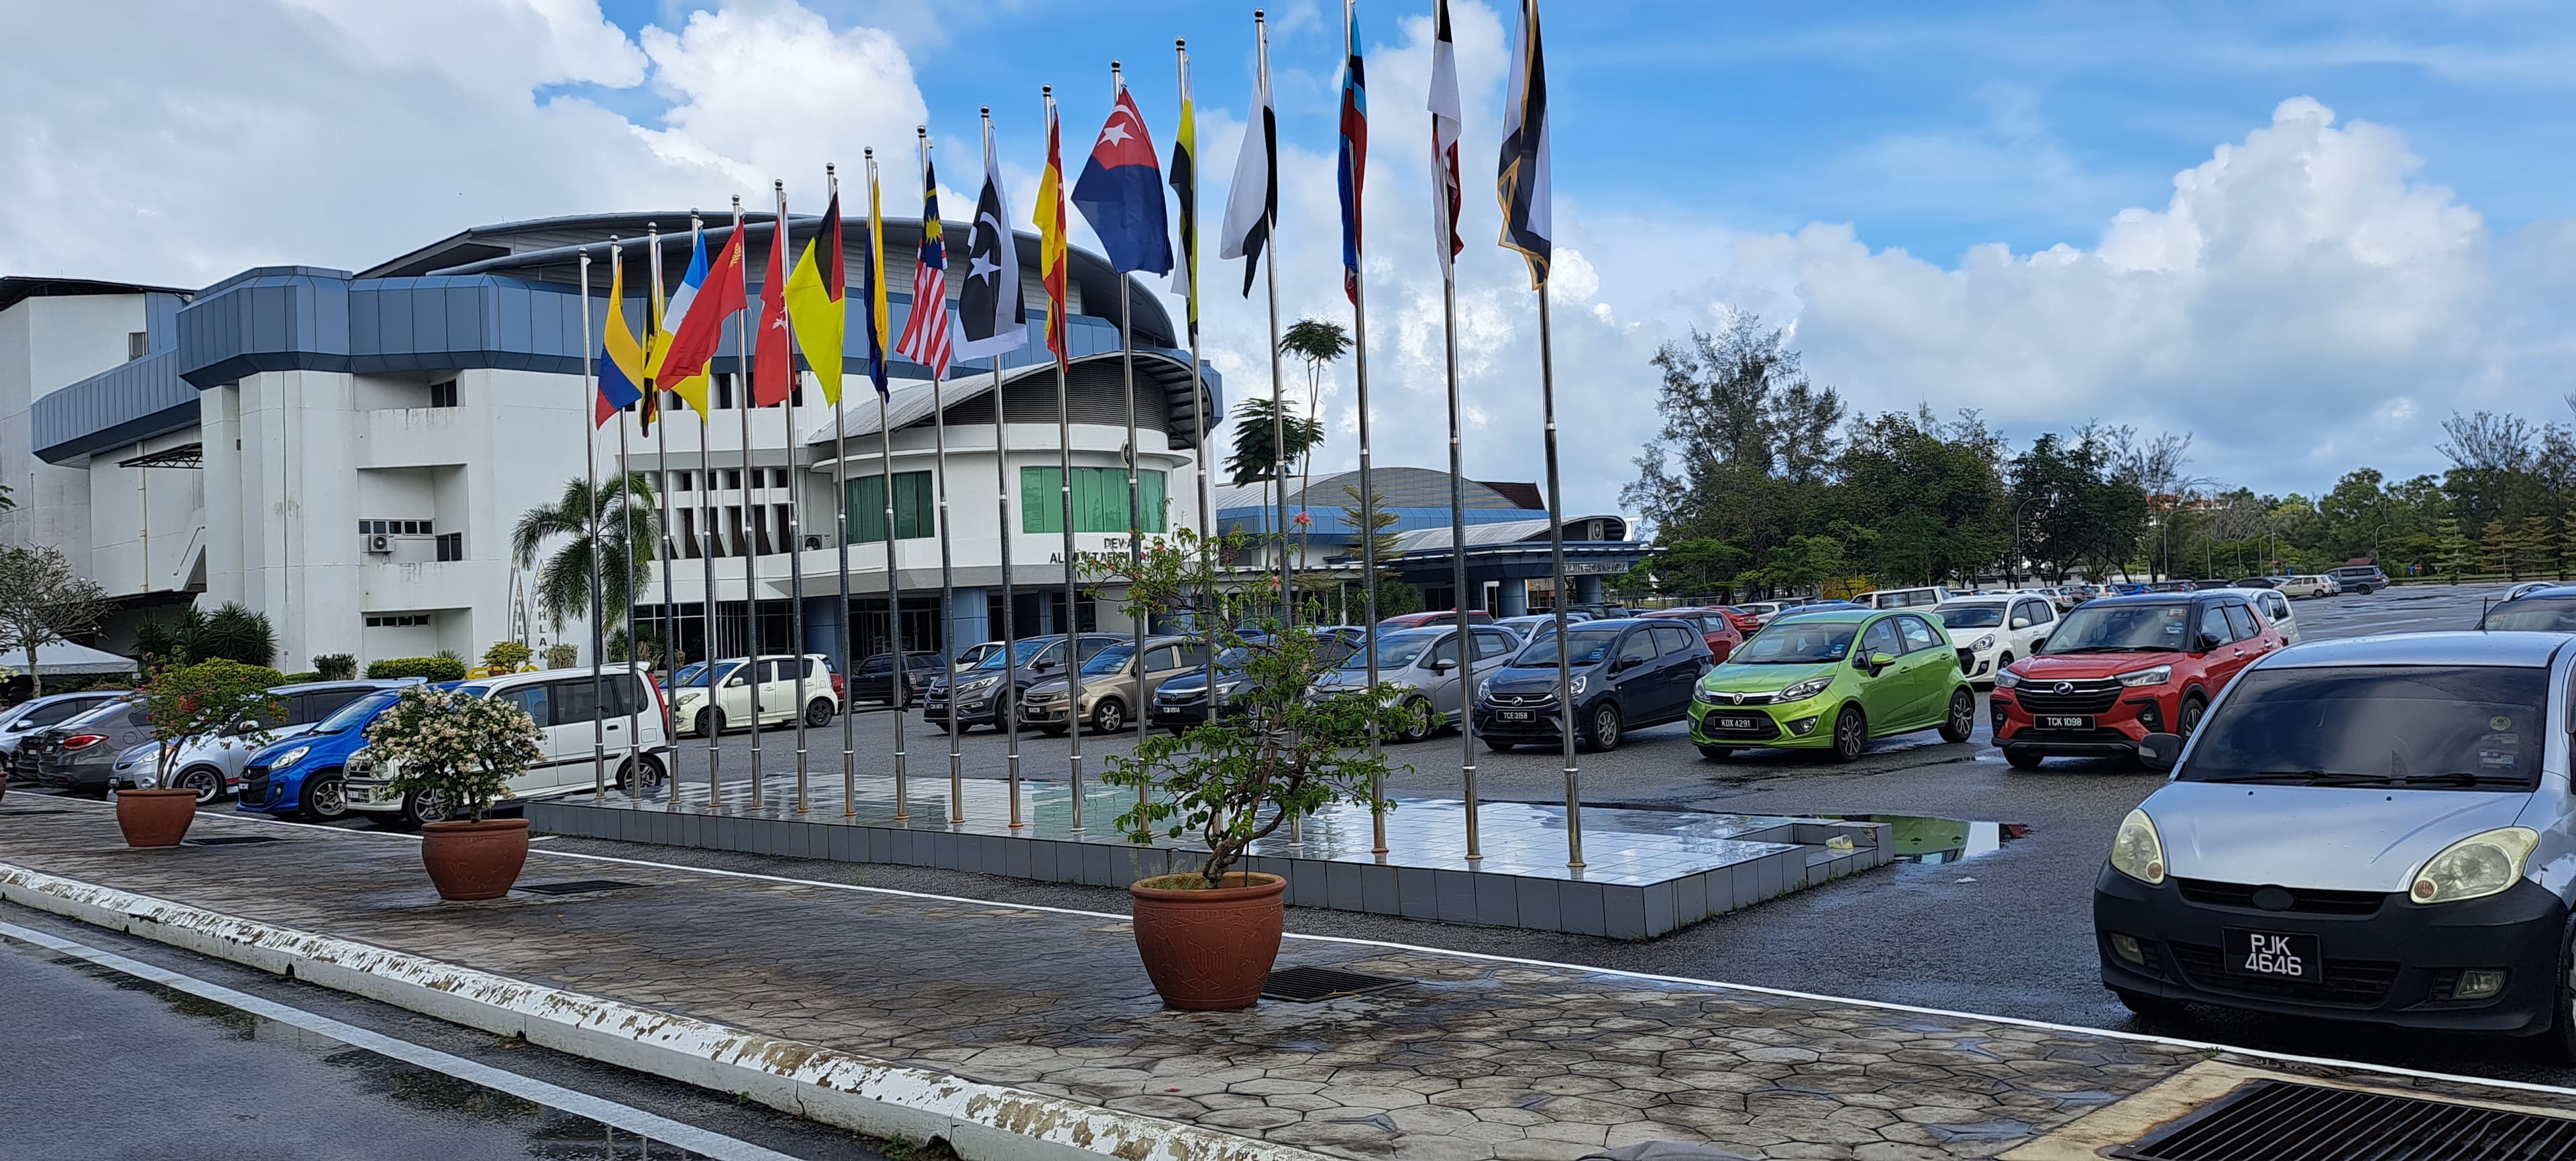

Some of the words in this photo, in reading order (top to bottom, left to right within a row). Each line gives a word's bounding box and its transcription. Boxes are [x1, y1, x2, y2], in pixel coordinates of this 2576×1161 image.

[1104, 538, 1134, 549] DEWA
[1721, 719, 1733, 727] KDX
[1735, 719, 1750, 727] 4291
[2047, 717, 2062, 726] TCK
[2064, 717, 2082, 726] 1098
[2251, 934, 2292, 956] PJK
[2245, 952, 2302, 976] 4646
